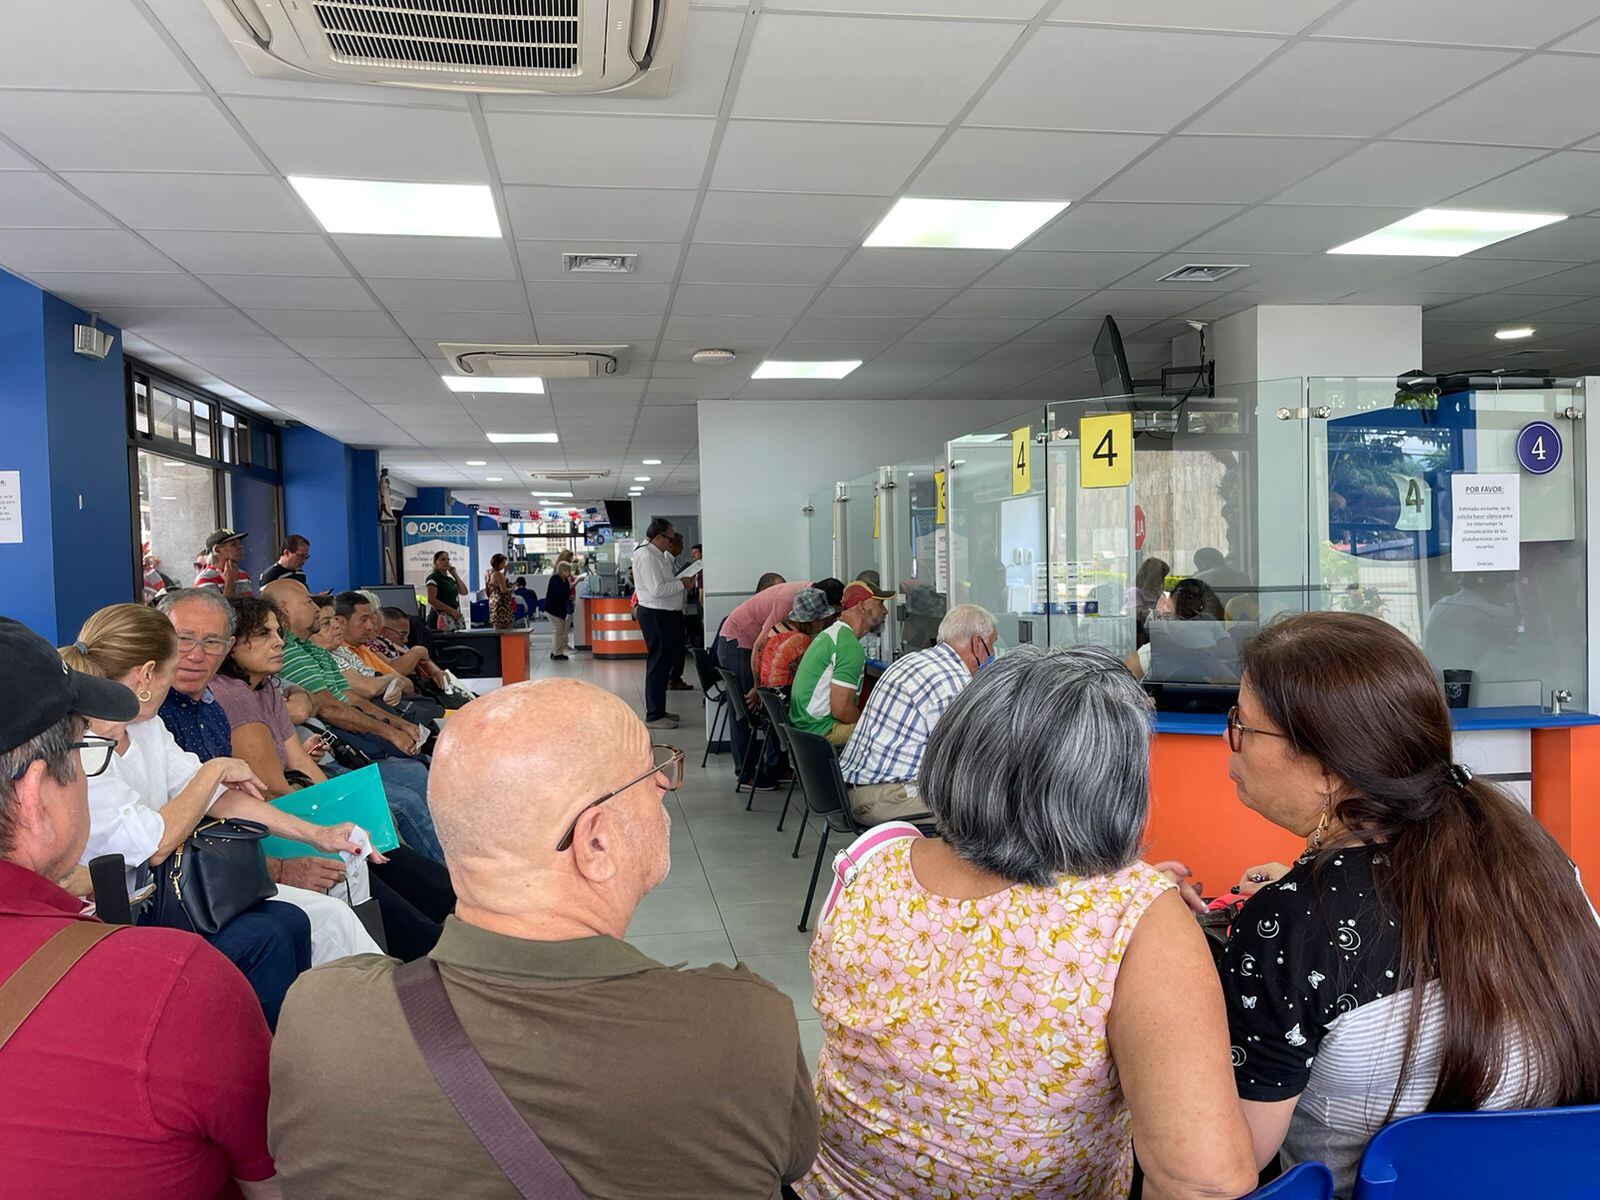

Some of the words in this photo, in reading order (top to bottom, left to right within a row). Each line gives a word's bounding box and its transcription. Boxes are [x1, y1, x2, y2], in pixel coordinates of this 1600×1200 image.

[1016, 441, 1025, 476] 4
[1092, 428, 1118, 467] 4
[1531, 435, 1546, 460] 4
[1405, 478, 1425, 513] 4
[1465, 485, 1479, 493] POR
